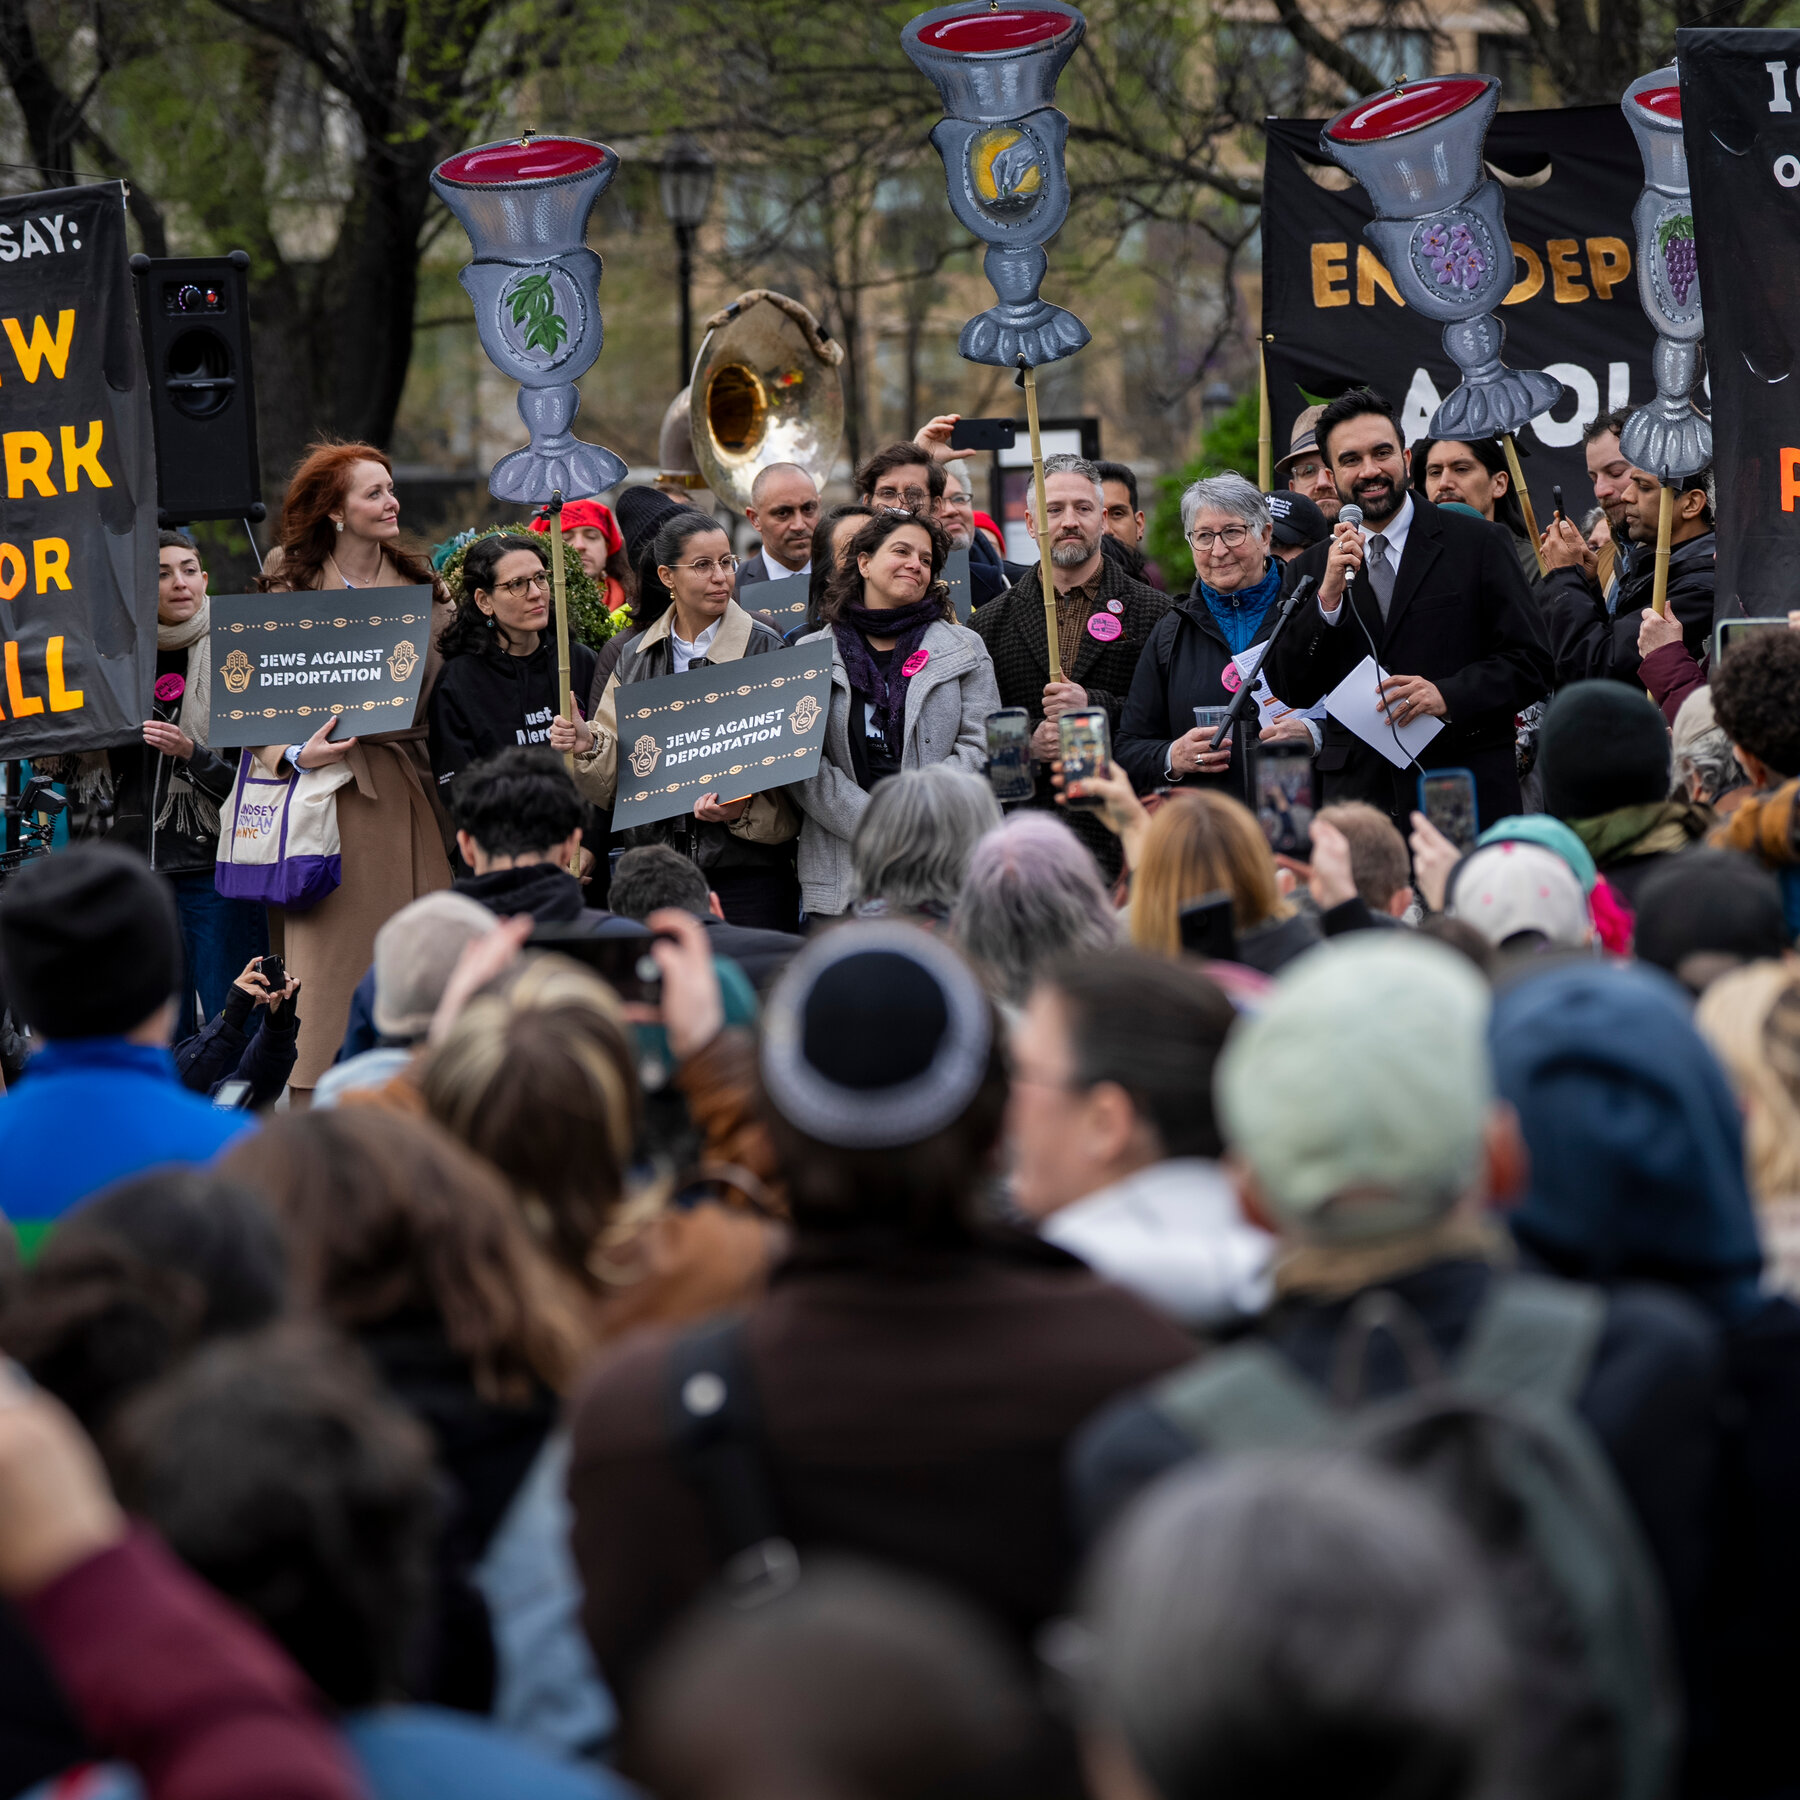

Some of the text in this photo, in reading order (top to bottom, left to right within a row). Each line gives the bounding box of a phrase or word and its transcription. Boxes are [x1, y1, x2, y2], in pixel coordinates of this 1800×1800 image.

[1765, 60, 1800, 113] I
[0, 214, 82, 263] SAY:
[1311, 242, 1407, 308] EN
[0, 309, 76, 387] W
[3, 420, 113, 499] RK
[0, 537, 73, 600] OR
[0, 635, 84, 721] LL
[260, 648, 384, 667] JEWS AGAINST
[260, 667, 382, 687] DEPORTATION
[525, 706, 553, 726] ust
[666, 708, 785, 749] JEWS AGAINST
[665, 725, 782, 767] DEPORTATION
